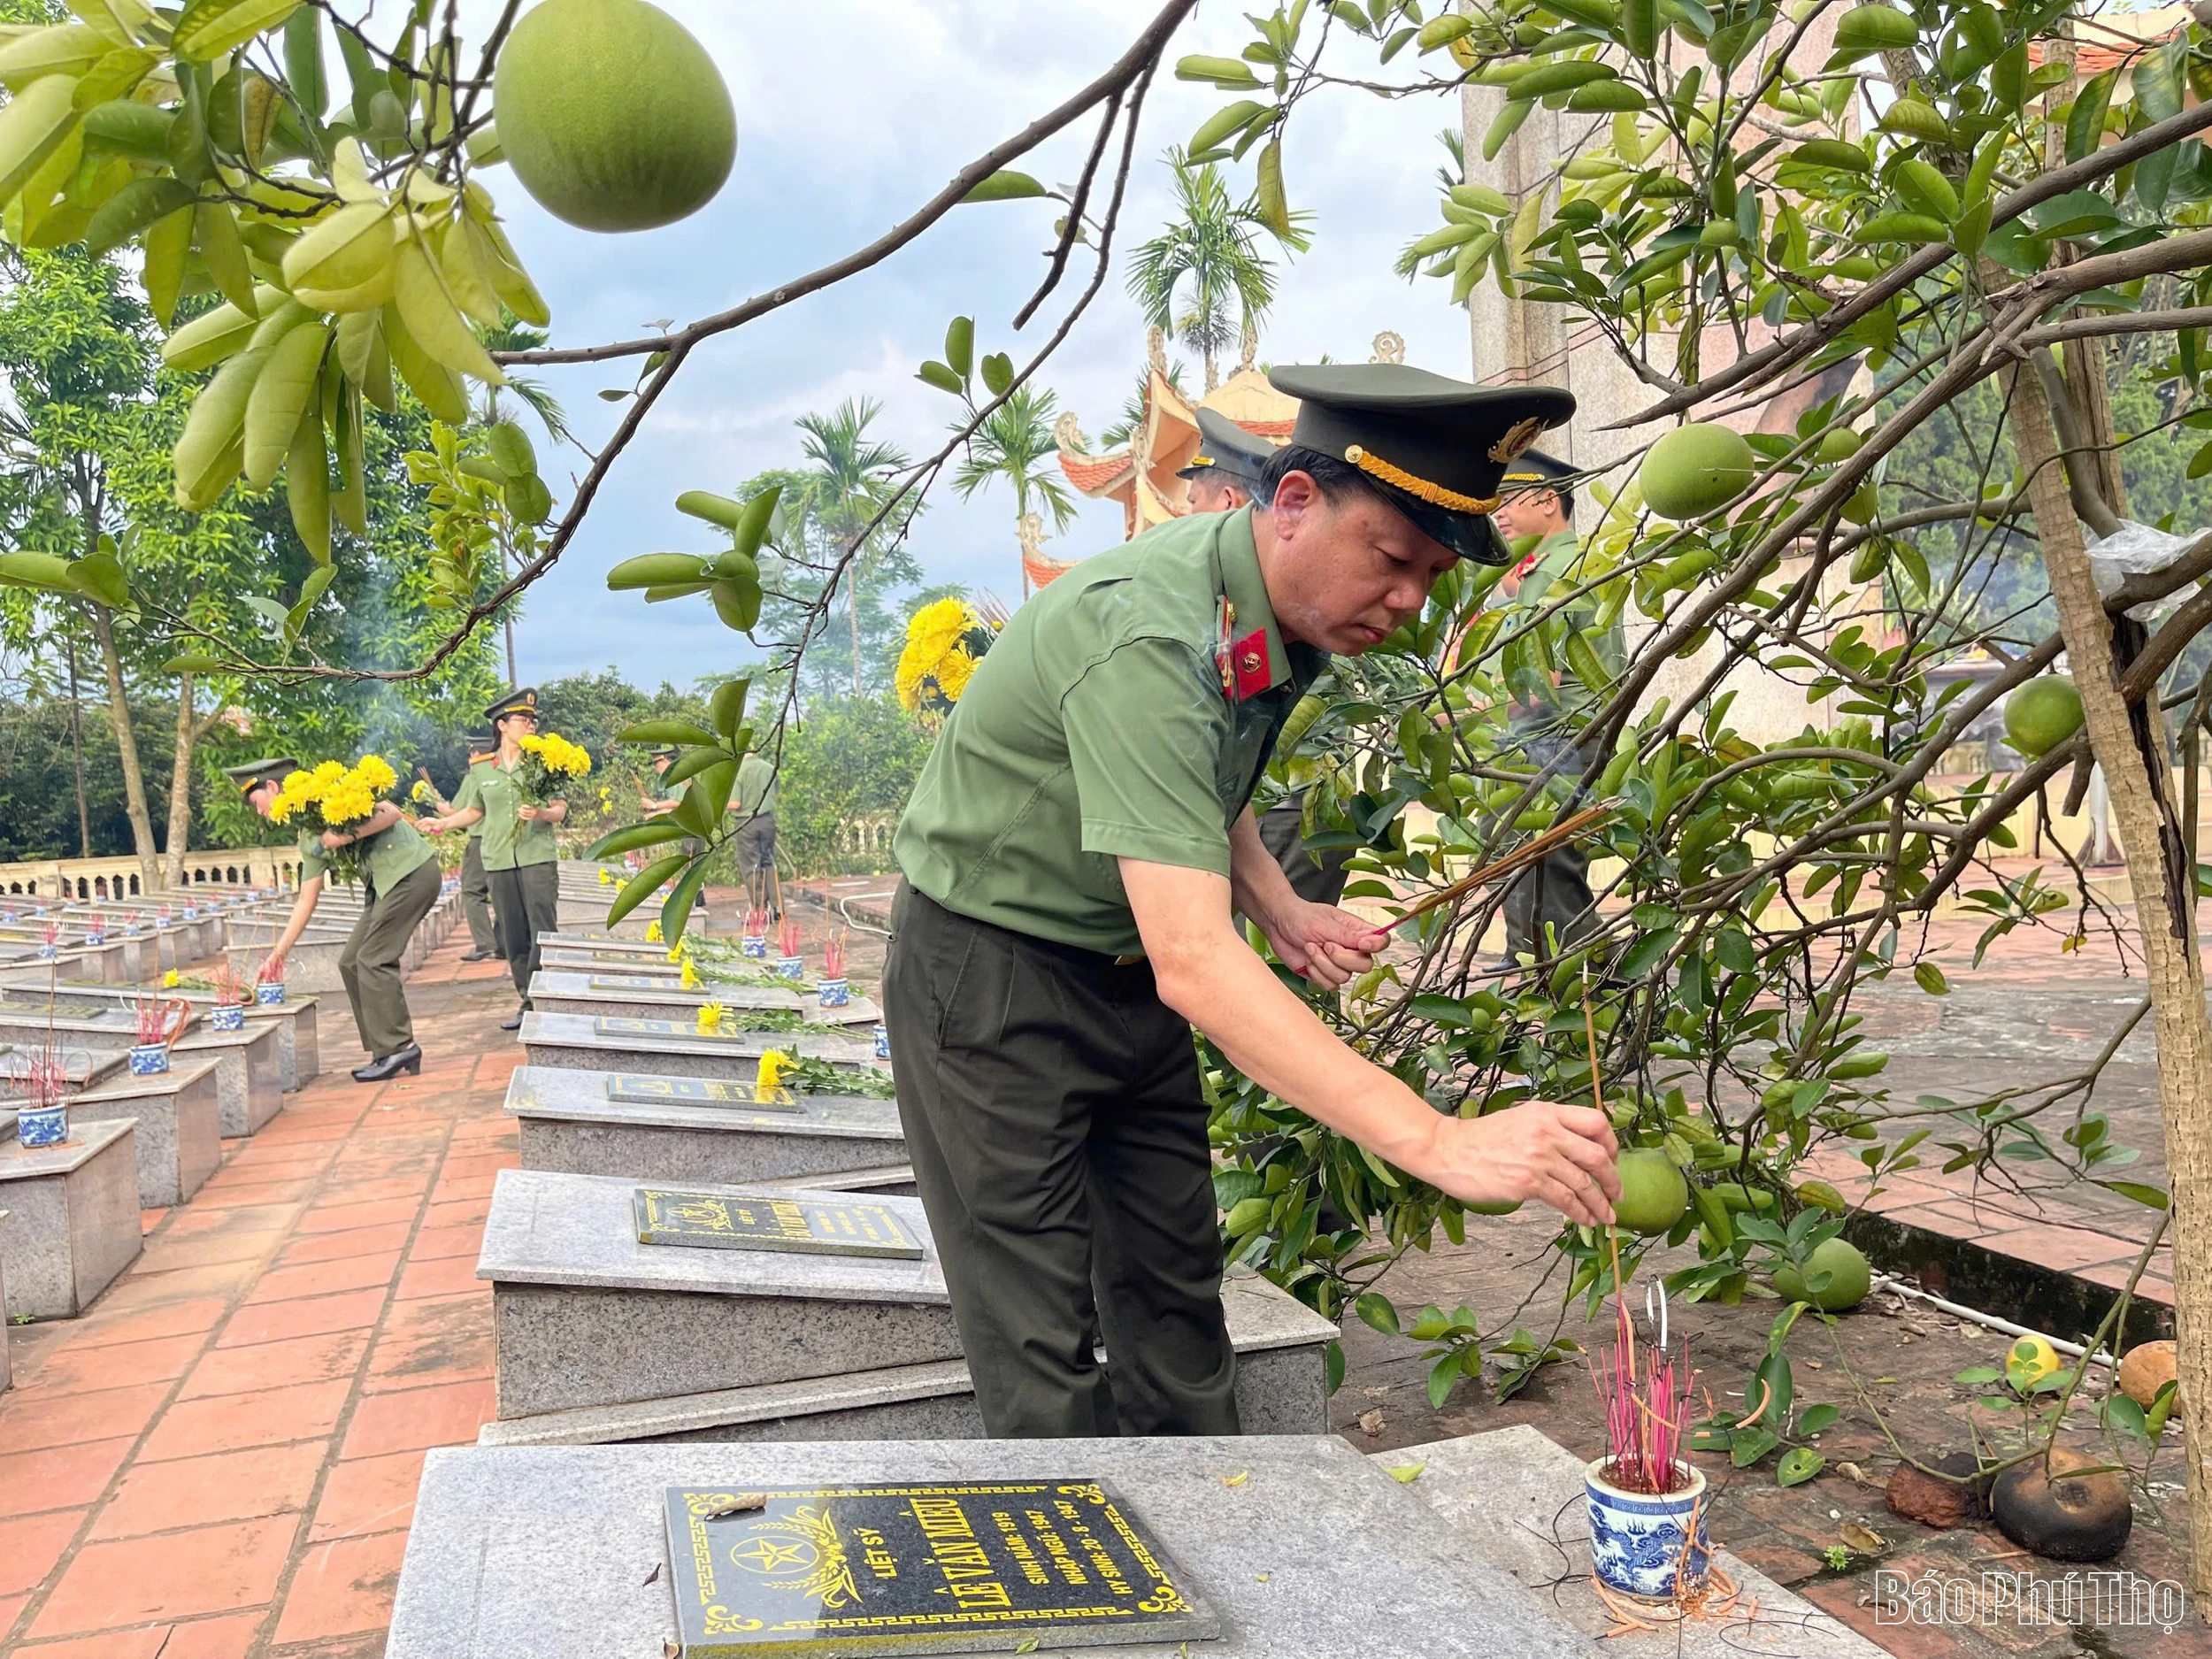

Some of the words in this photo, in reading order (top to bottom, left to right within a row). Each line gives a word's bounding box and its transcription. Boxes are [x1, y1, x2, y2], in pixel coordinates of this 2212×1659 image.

[899, 1498, 975, 1538] MIÊU
[991, 1511, 1018, 1532] 1919
[1025, 1510, 1052, 1530] 1947
[1053, 1500, 1080, 1520] 1947
[852, 1527, 884, 1546] SỸ
[1004, 1534, 1034, 1559] NĂM:
[1036, 1532, 1070, 1555] NGŨ:
[1080, 1539, 1103, 1550] 20
[864, 1548, 898, 1578] LIỆT
[922, 1542, 995, 1580] VĂN
[1018, 1561, 1050, 1585] SINH
[1054, 1556, 1089, 1585] NHẬP
[1090, 1552, 1121, 1578] SINH:
[933, 1582, 1012, 1609] LÊ
[1106, 1579, 1133, 1594] HY
